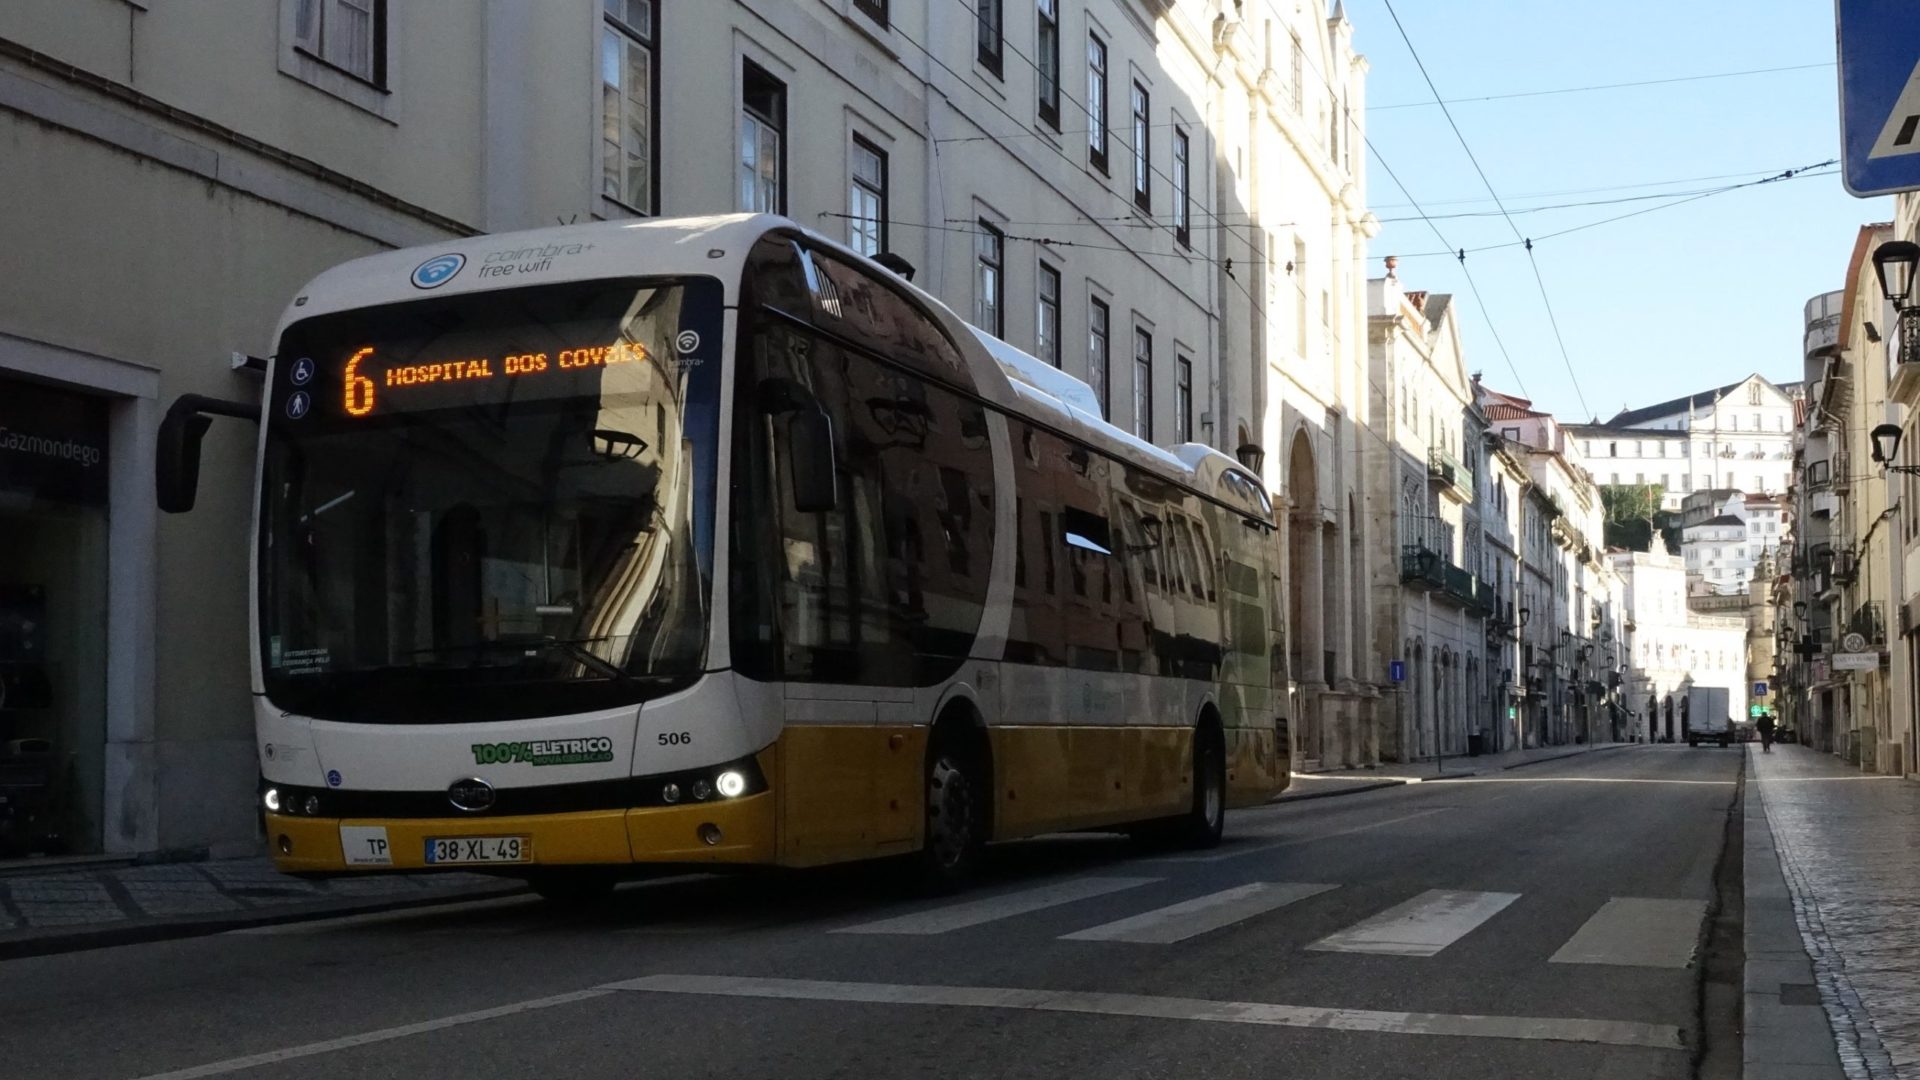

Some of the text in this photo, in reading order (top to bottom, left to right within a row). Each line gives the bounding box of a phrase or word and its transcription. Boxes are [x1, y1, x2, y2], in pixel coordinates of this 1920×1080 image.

[484, 244, 595, 263] coimbra+
[478, 257, 551, 278] free wifi
[386, 358, 493, 386] HOSPITAL
[504, 353, 547, 374] DOS
[345, 346, 373, 416] 6
[0, 427, 100, 467] Gazmondego
[658, 731, 691, 746] 506
[471, 742, 532, 765] 100%
[366, 839, 387, 855] TP
